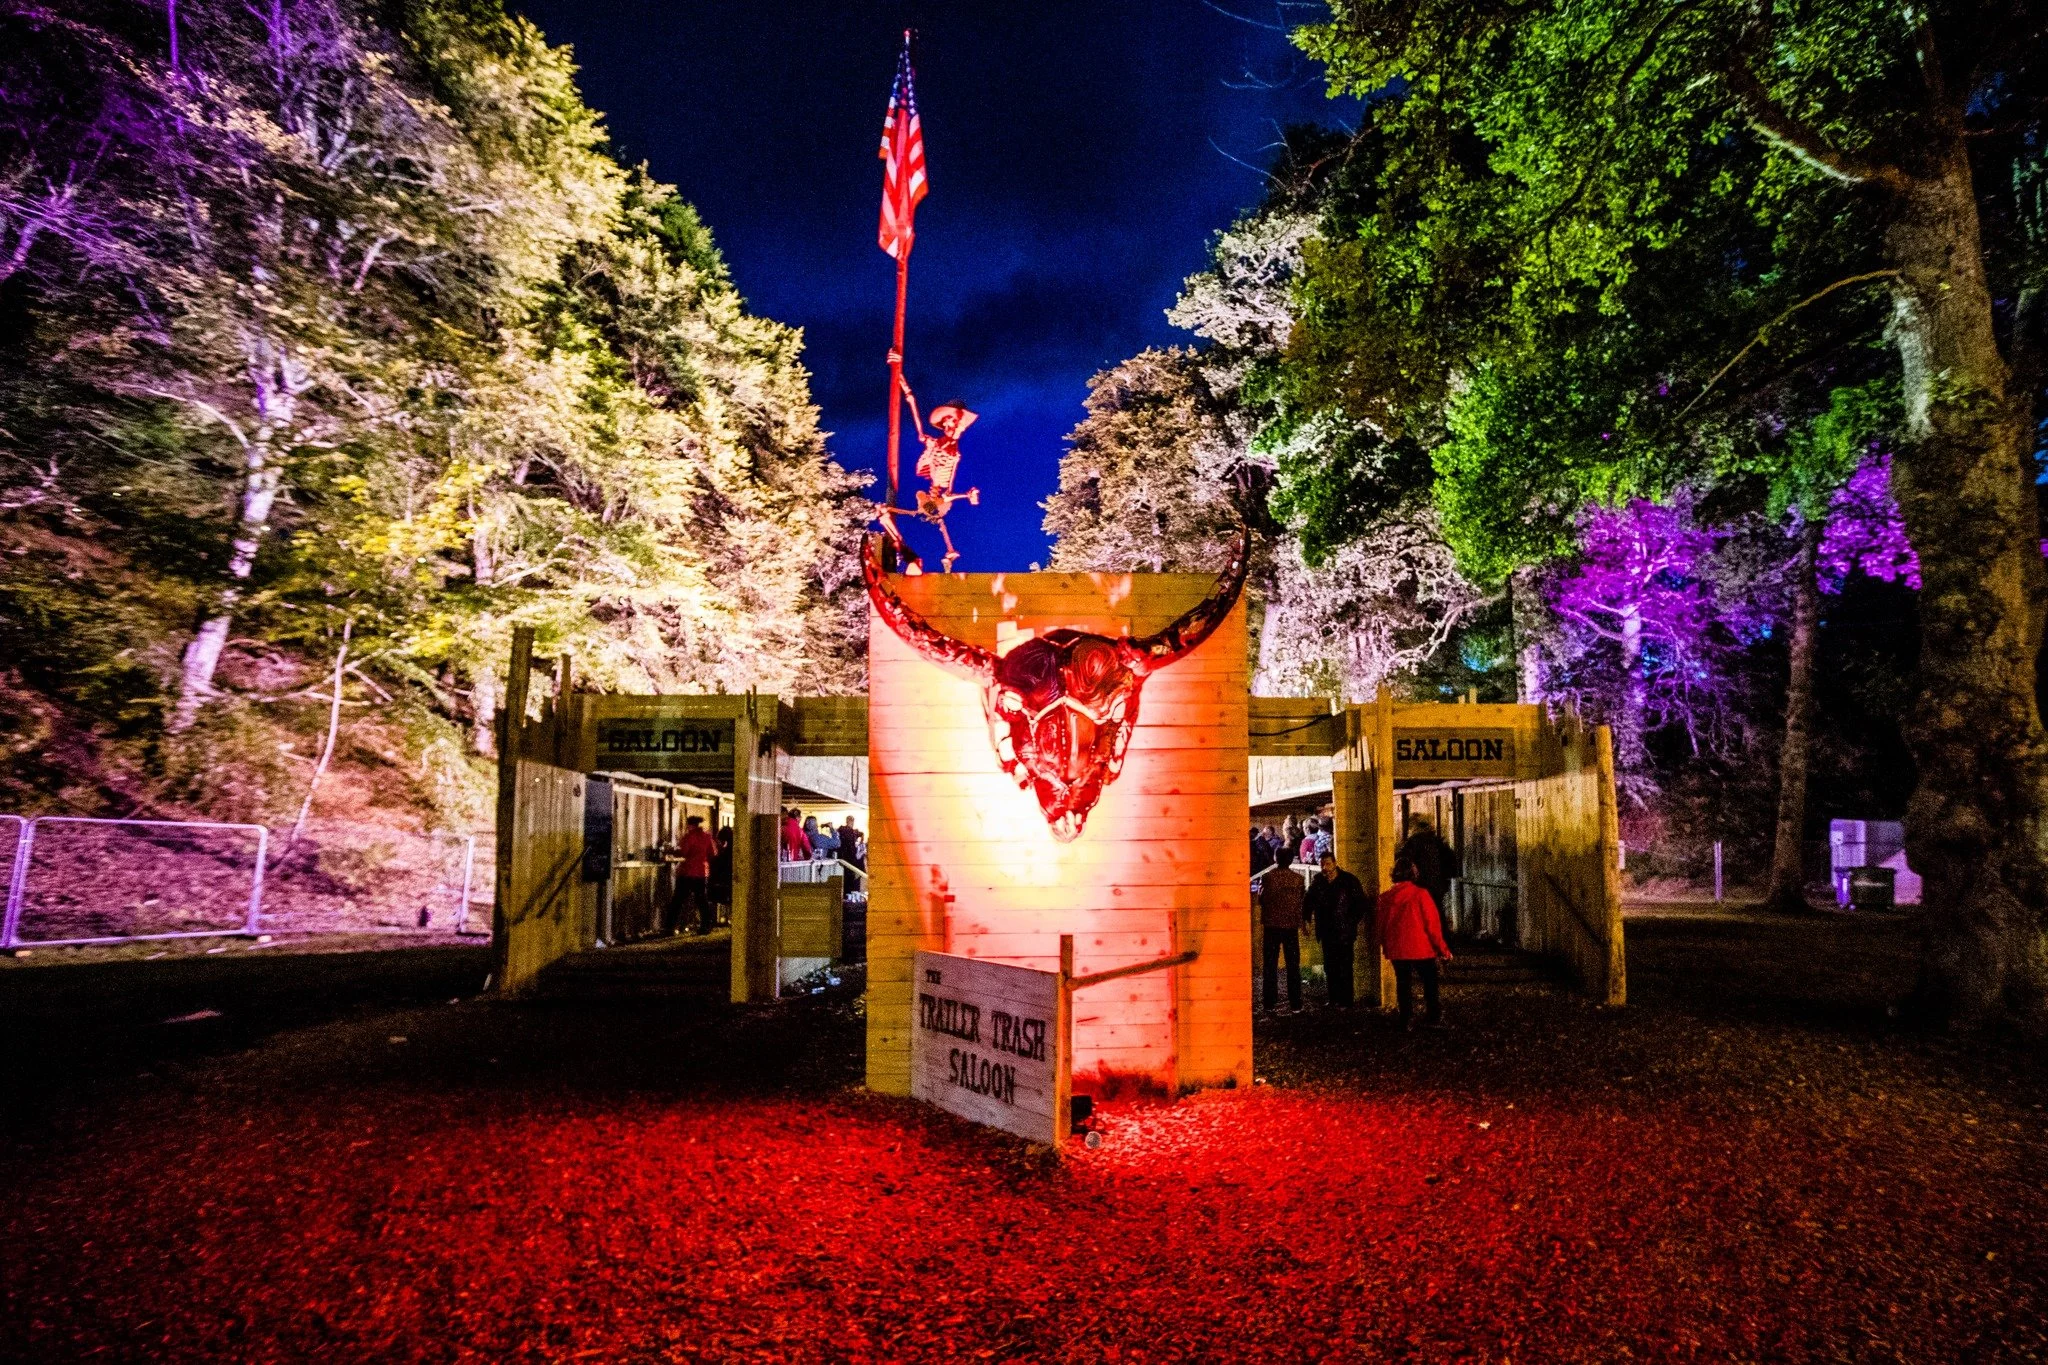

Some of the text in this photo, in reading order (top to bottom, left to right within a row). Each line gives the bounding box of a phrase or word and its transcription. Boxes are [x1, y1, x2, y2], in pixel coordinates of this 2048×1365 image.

[609, 729, 721, 752] SALOON
[1396, 739, 1503, 761] SALOON
[926, 969, 941, 984] THE
[919, 993, 1046, 1062] TRAILER TRASH
[949, 1048, 1015, 1105] SALOON
